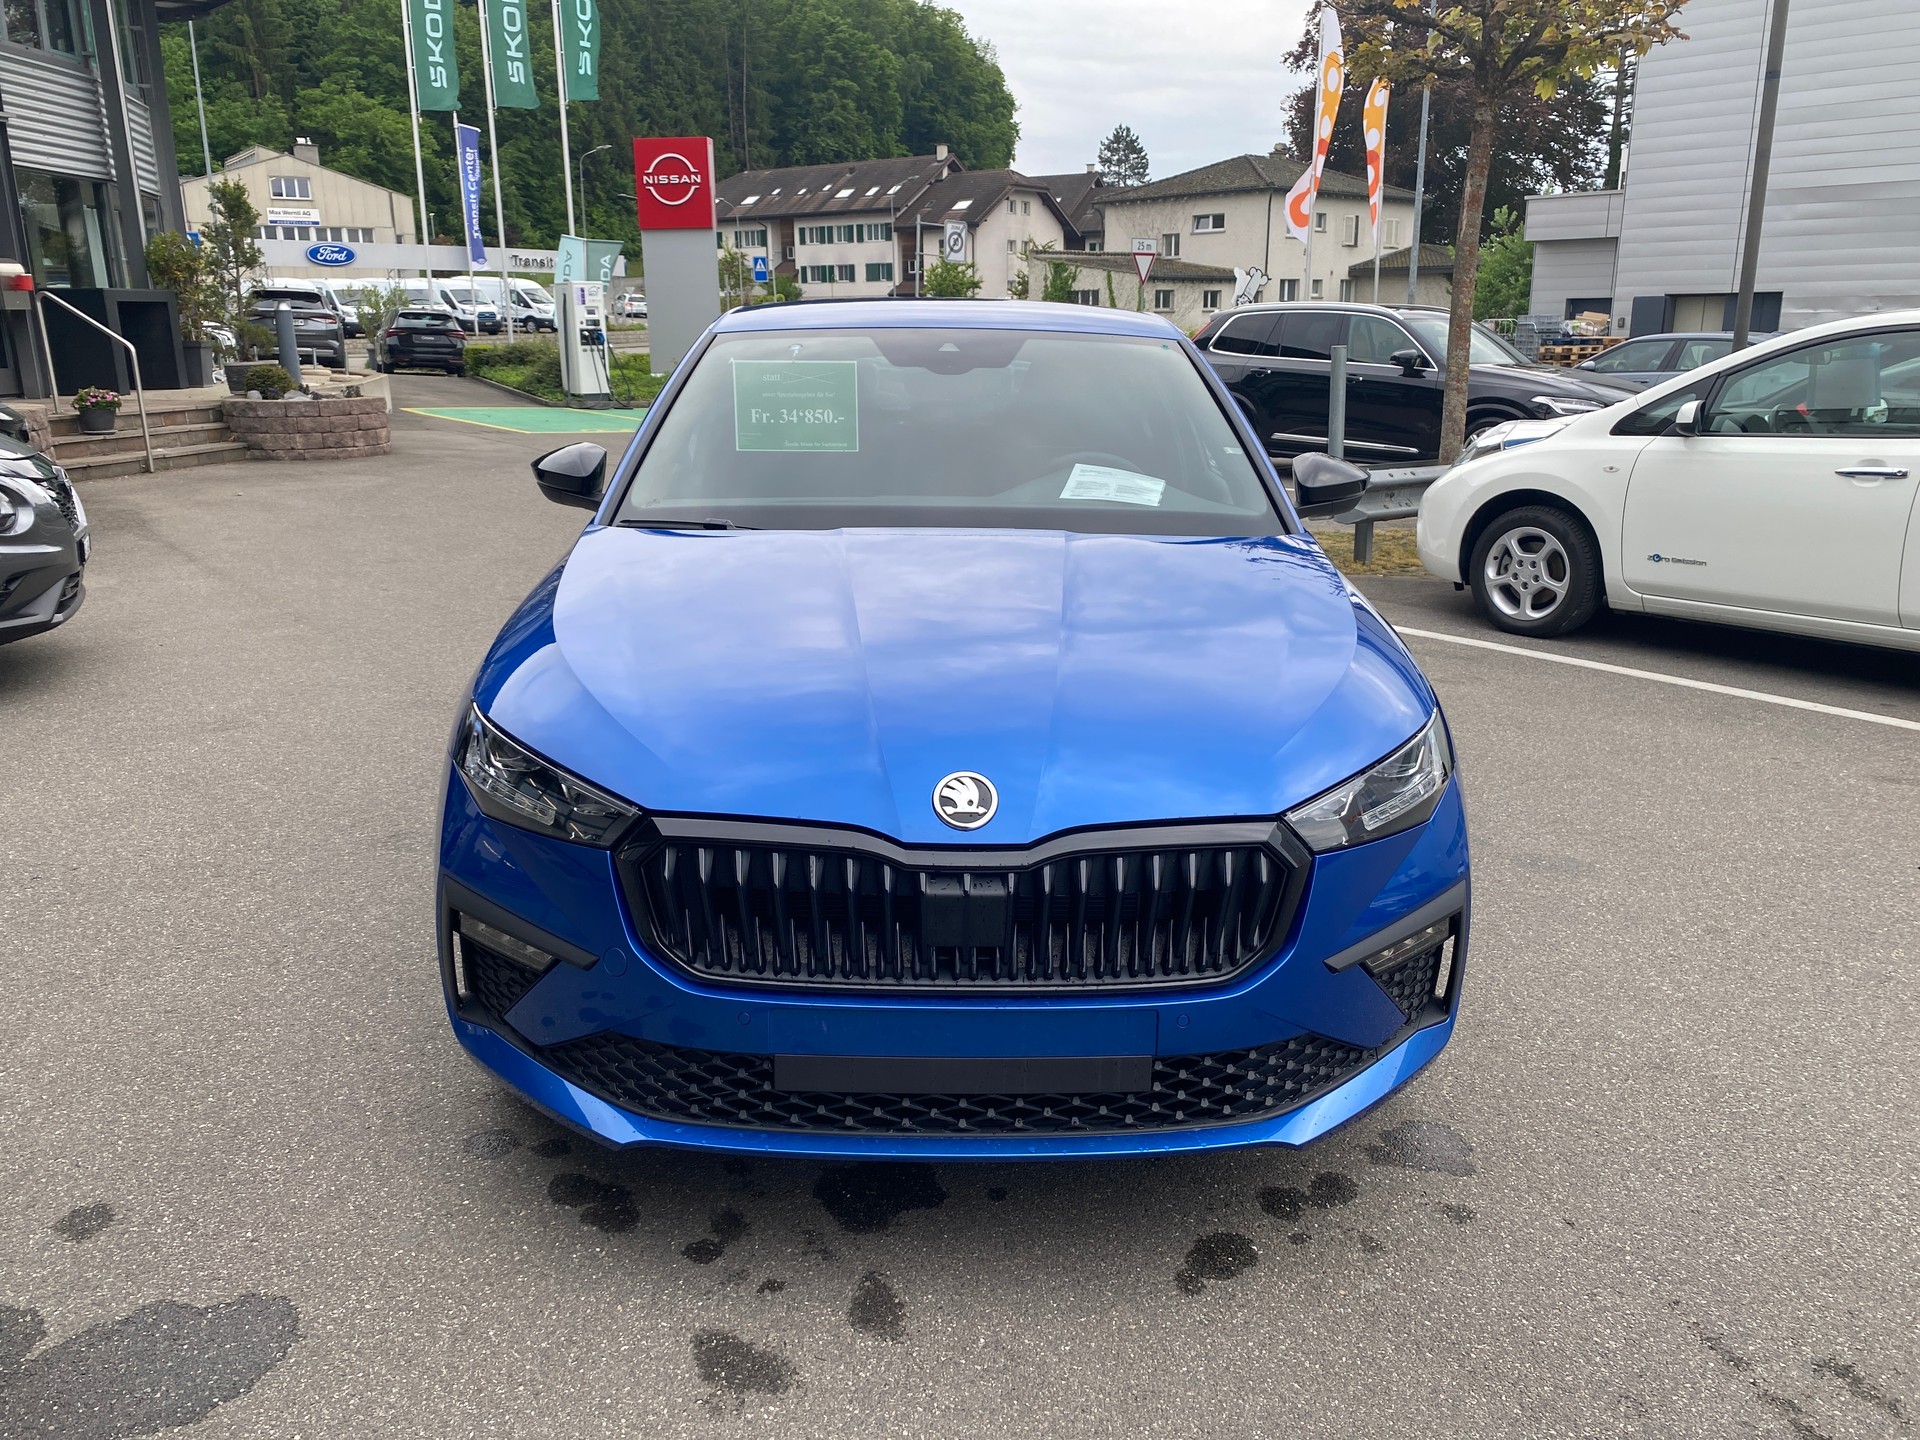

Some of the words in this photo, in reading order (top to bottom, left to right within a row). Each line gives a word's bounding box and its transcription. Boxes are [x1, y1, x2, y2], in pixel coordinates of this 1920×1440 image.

[465, 146, 478, 191] Center
[643, 174, 701, 184] NISSAN
[1137, 241, 1145, 251] 25
[316, 246, 347, 261] Ford
[511, 254, 554, 268] Transit
[762, 373, 780, 382] statt
[750, 408, 774, 424] Fr.
